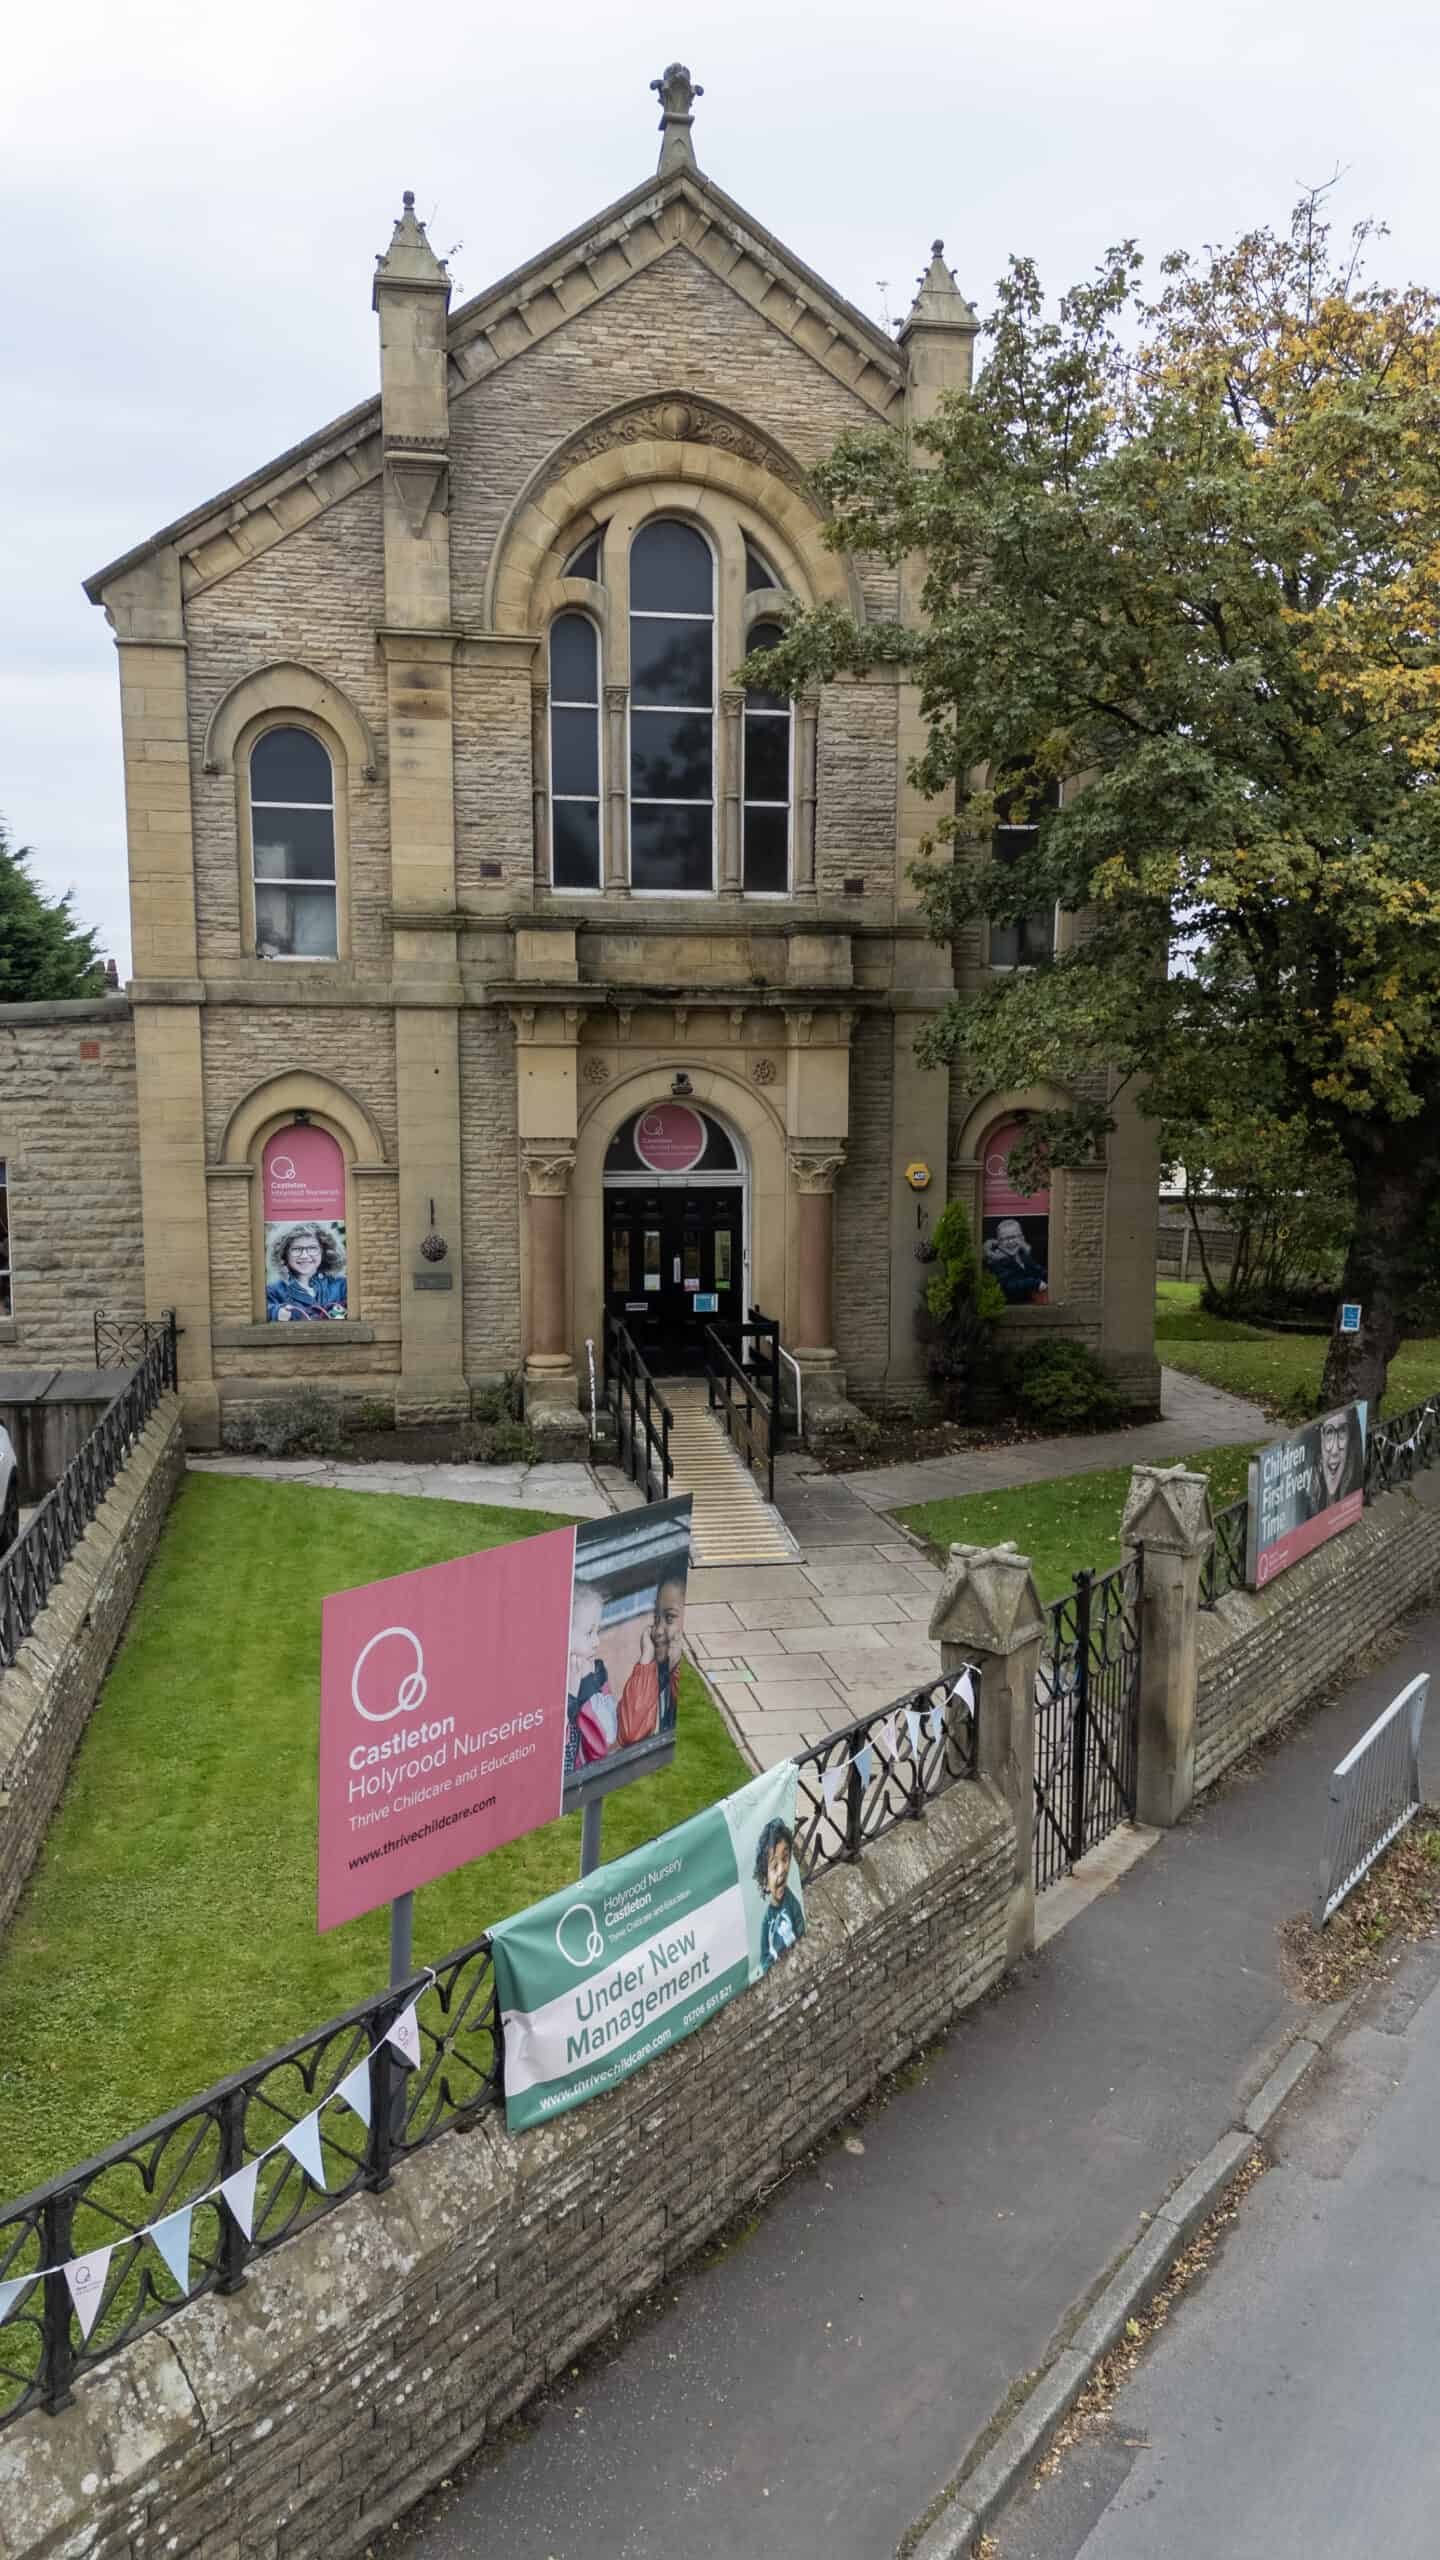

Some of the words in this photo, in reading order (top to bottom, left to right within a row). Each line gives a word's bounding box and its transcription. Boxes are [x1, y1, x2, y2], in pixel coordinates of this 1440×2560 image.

[1262, 1480, 1284, 1513] First
[1263, 1445, 1305, 1484] Children
[1286, 1466, 1313, 1499] Every
[348, 1745, 447, 1803] Holyrood
[453, 1708, 544, 1760] Nurseries
[349, 1715, 455, 1770] Castleton
[349, 1805, 390, 1831] Thrive
[393, 1778, 452, 1813] Childcare
[455, 1768, 477, 1786] and
[480, 1743, 536, 1776] Education
[348, 1795, 497, 1871] www.thrivechildcare.com
[603, 1875, 647, 1912] Holyrood
[647, 1856, 684, 1886] Nursery
[604, 1893, 652, 1926] Castleton
[566, 1952, 710, 2063] Management
[576, 1964, 645, 2022] Under
[648, 1930, 695, 1976] New
[539, 2028, 672, 2112] www.thrivechildcare.com
